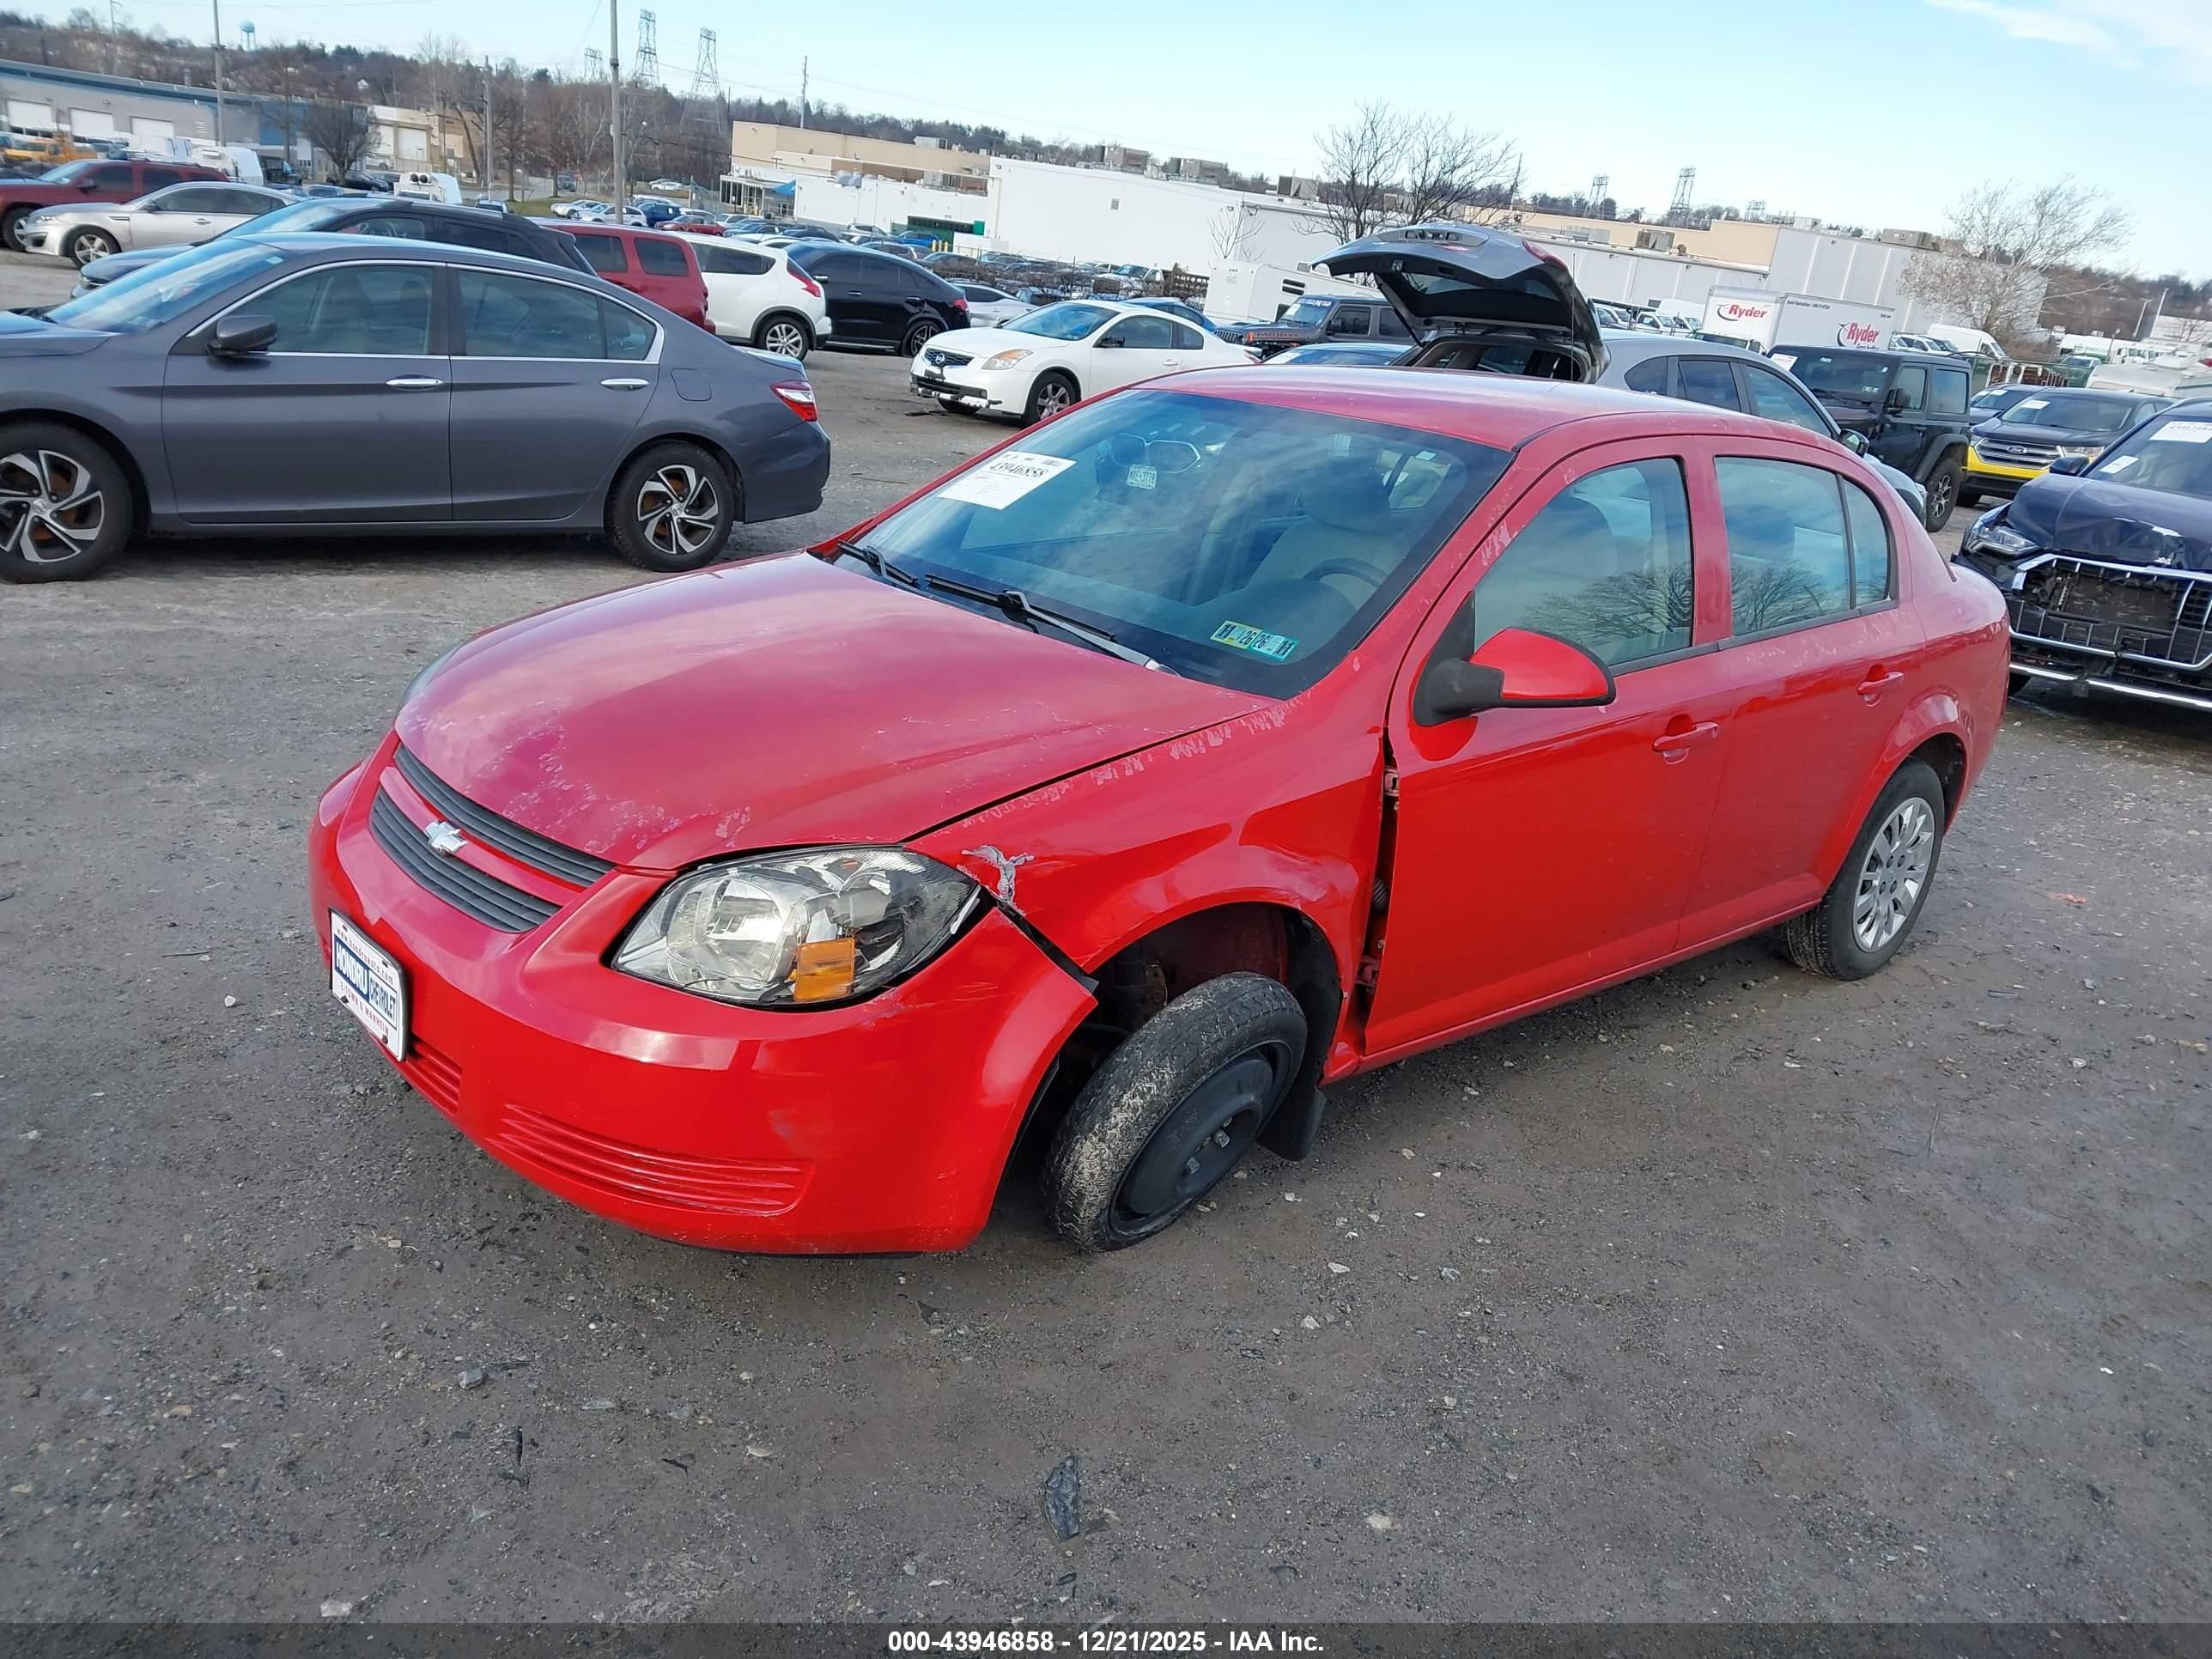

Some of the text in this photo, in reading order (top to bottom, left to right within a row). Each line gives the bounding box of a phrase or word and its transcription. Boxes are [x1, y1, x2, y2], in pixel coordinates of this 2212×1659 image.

[1729, 304, 1768, 318] Ryder
[1847, 322, 1880, 344] Ryder
[989, 461, 1049, 478] 43946858
[1218, 624, 1237, 639] 11
[1276, 641, 1295, 655] 11
[336, 941, 368, 995] HONDRU
